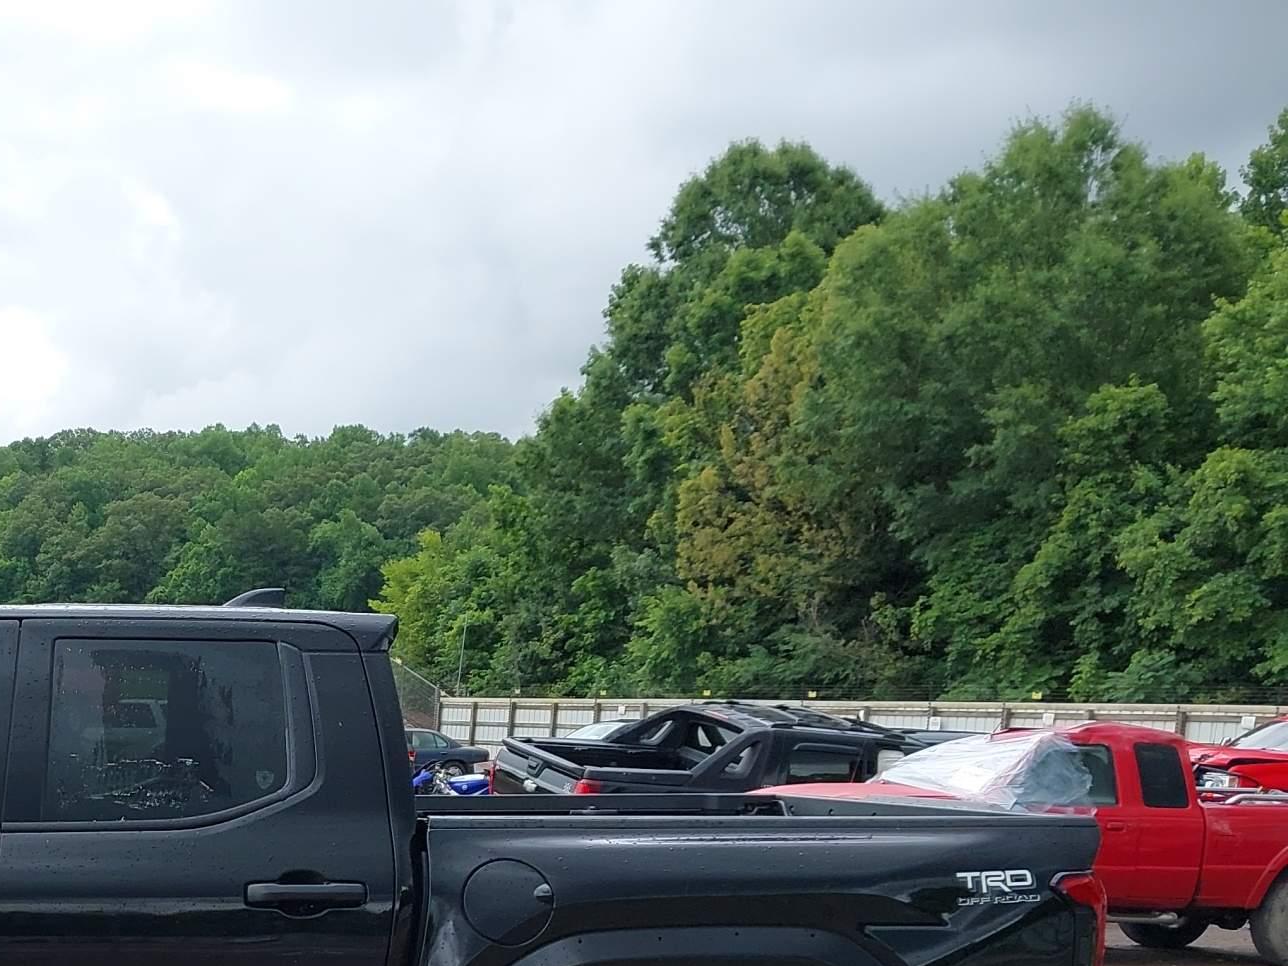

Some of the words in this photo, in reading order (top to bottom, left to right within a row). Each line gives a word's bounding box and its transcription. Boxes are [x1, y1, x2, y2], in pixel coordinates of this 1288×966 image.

[956, 870, 1033, 893] TRD
[958, 896, 992, 907] OFF
[993, 894, 1041, 906] ROAD
